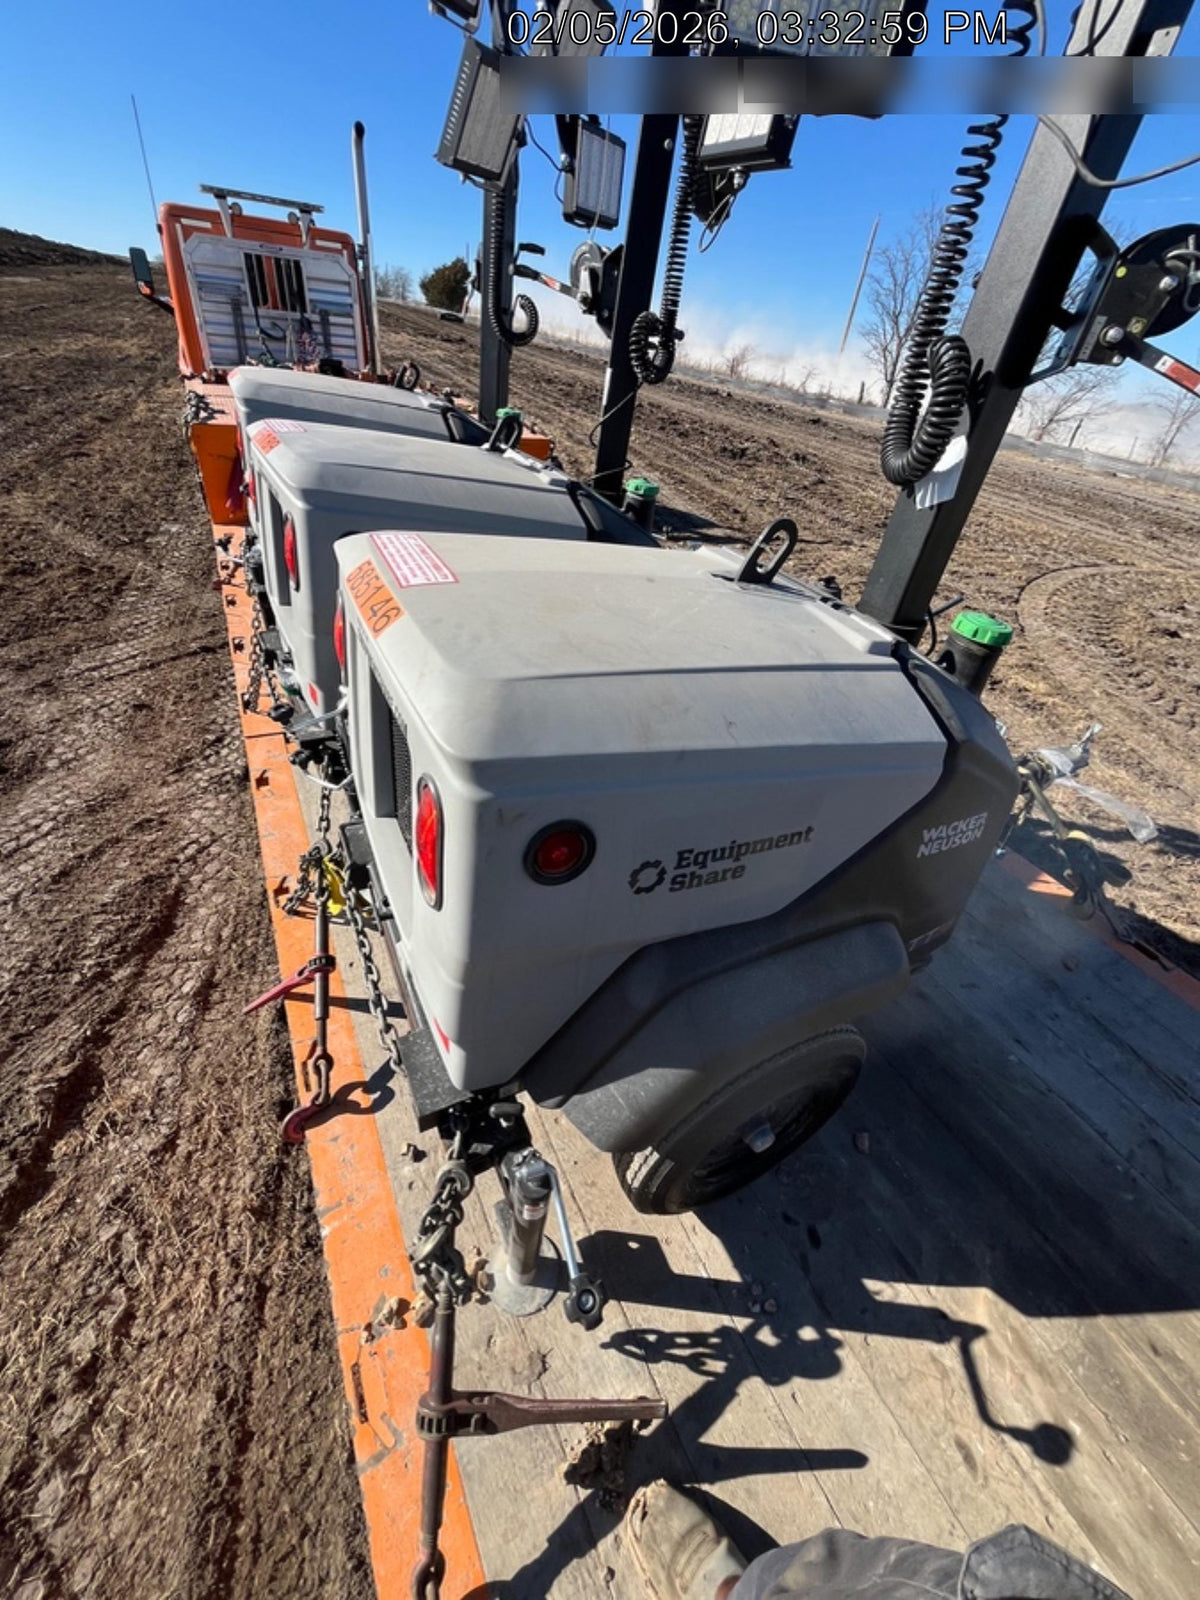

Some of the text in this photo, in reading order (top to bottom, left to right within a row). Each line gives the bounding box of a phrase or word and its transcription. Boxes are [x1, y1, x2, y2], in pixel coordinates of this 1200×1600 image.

[916, 826, 985, 858] NEUSON
[922, 812, 988, 843] WACKER
[673, 826, 815, 870] Equipment
[668, 864, 746, 892] Share
